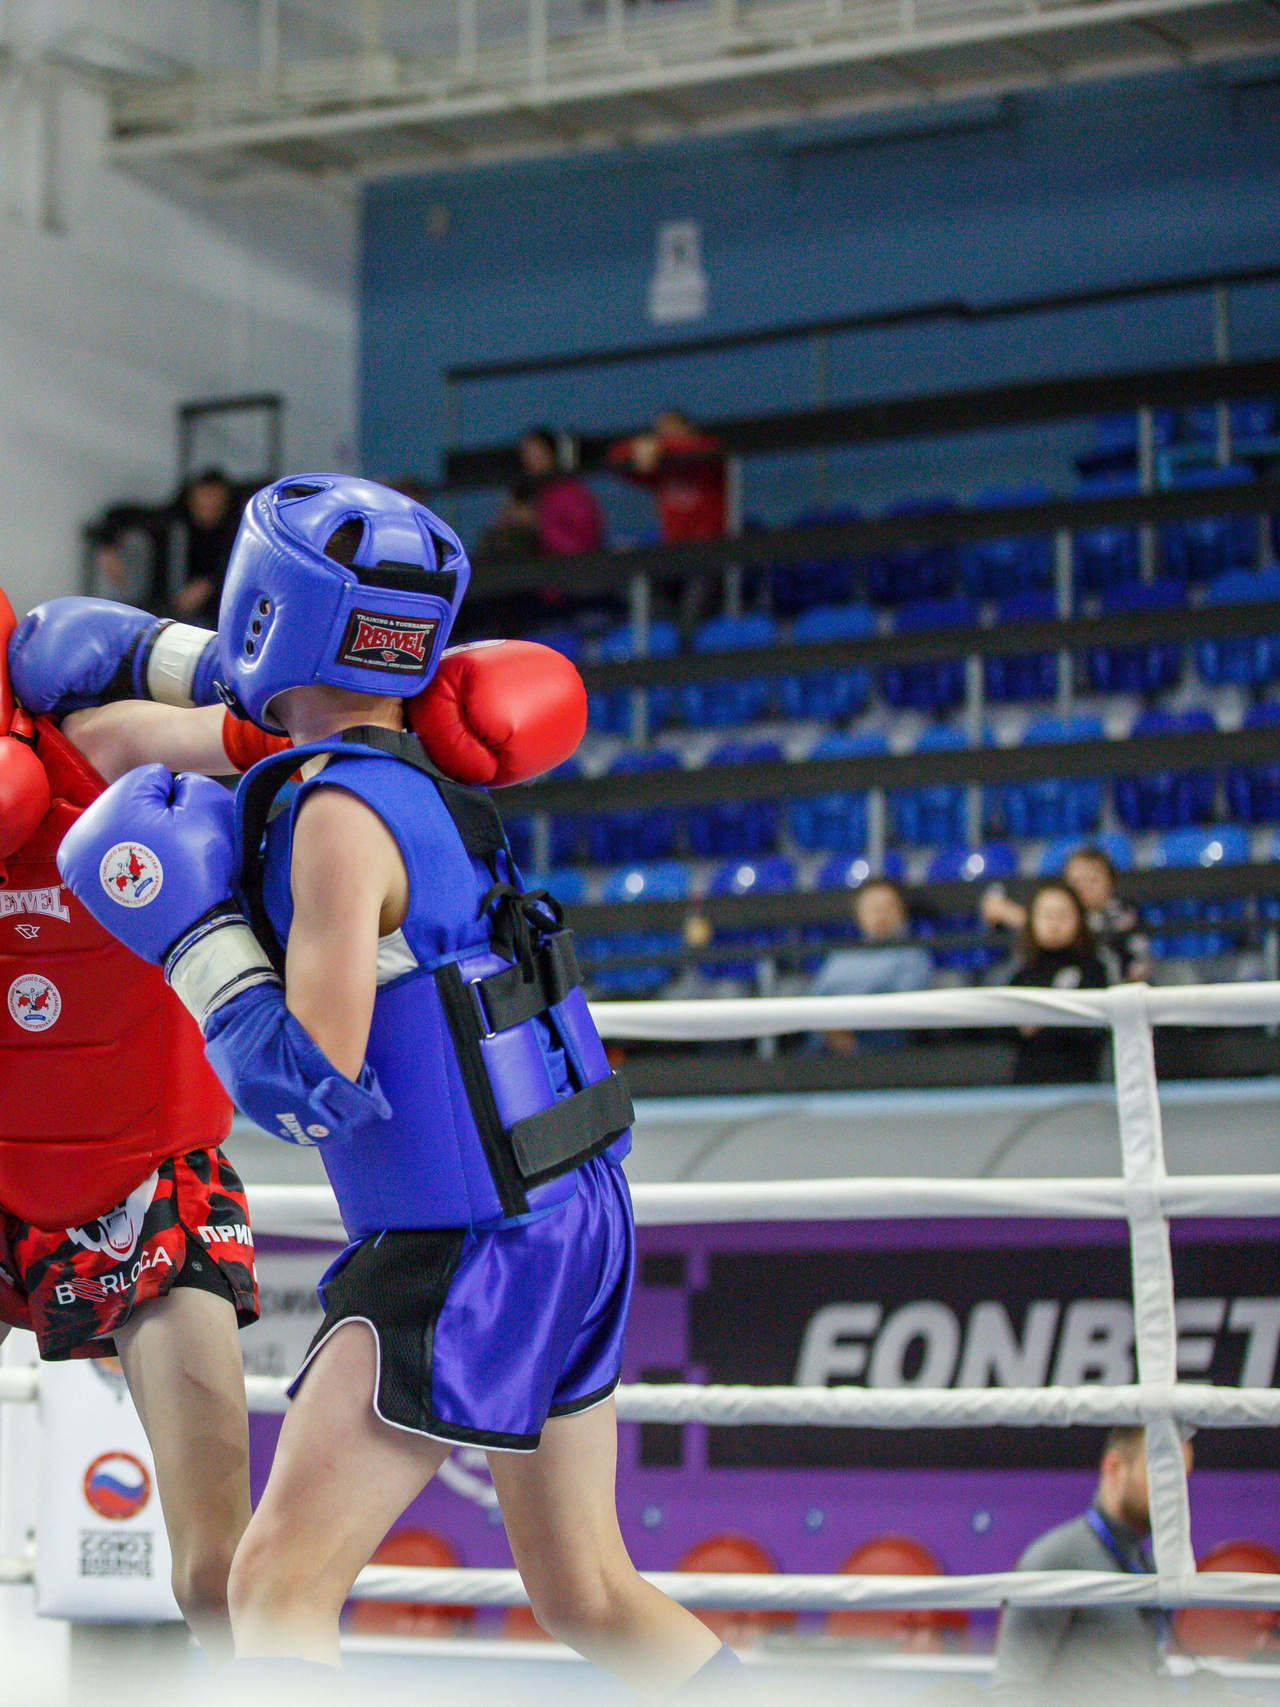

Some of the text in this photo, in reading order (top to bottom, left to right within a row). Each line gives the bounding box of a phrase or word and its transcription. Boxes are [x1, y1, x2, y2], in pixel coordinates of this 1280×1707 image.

[357, 614, 388, 625] TRAINING
[396, 621, 434, 629] TOURNAMENT
[352, 620, 425, 661] REYVEL
